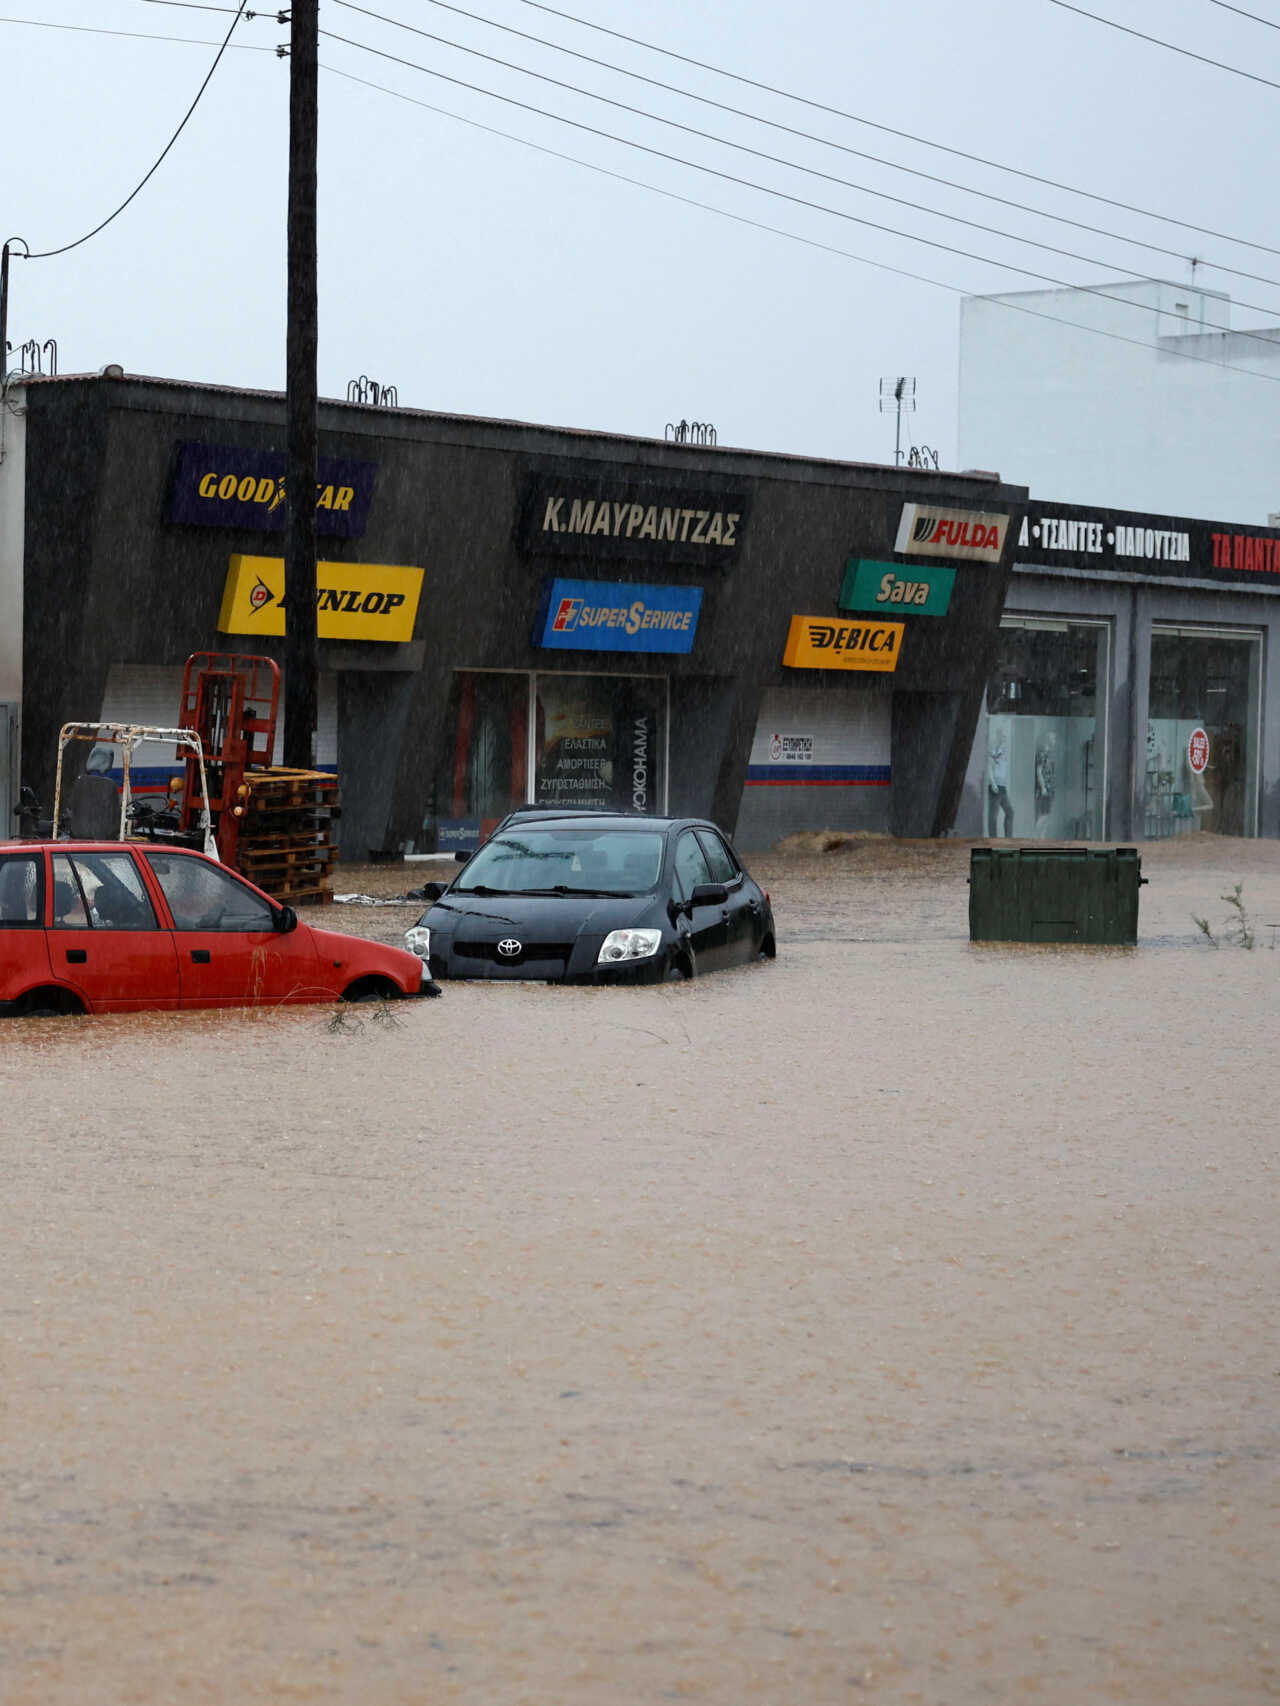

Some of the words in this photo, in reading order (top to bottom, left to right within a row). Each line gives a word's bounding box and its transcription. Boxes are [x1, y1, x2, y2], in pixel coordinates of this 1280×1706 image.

[542, 496, 741, 547] Κ.ΜΑΥΡΑΝΤΖΑΣ
[928, 518, 1000, 551] FULDA
[1040, 517, 1104, 553] ΤΣΑΝΤΕΣ
[1115, 525, 1190, 563] ΠΑΠΟΥΤΣΙΑ
[876, 572, 930, 606] Sava
[632, 717, 648, 812] YOKOHAMA
